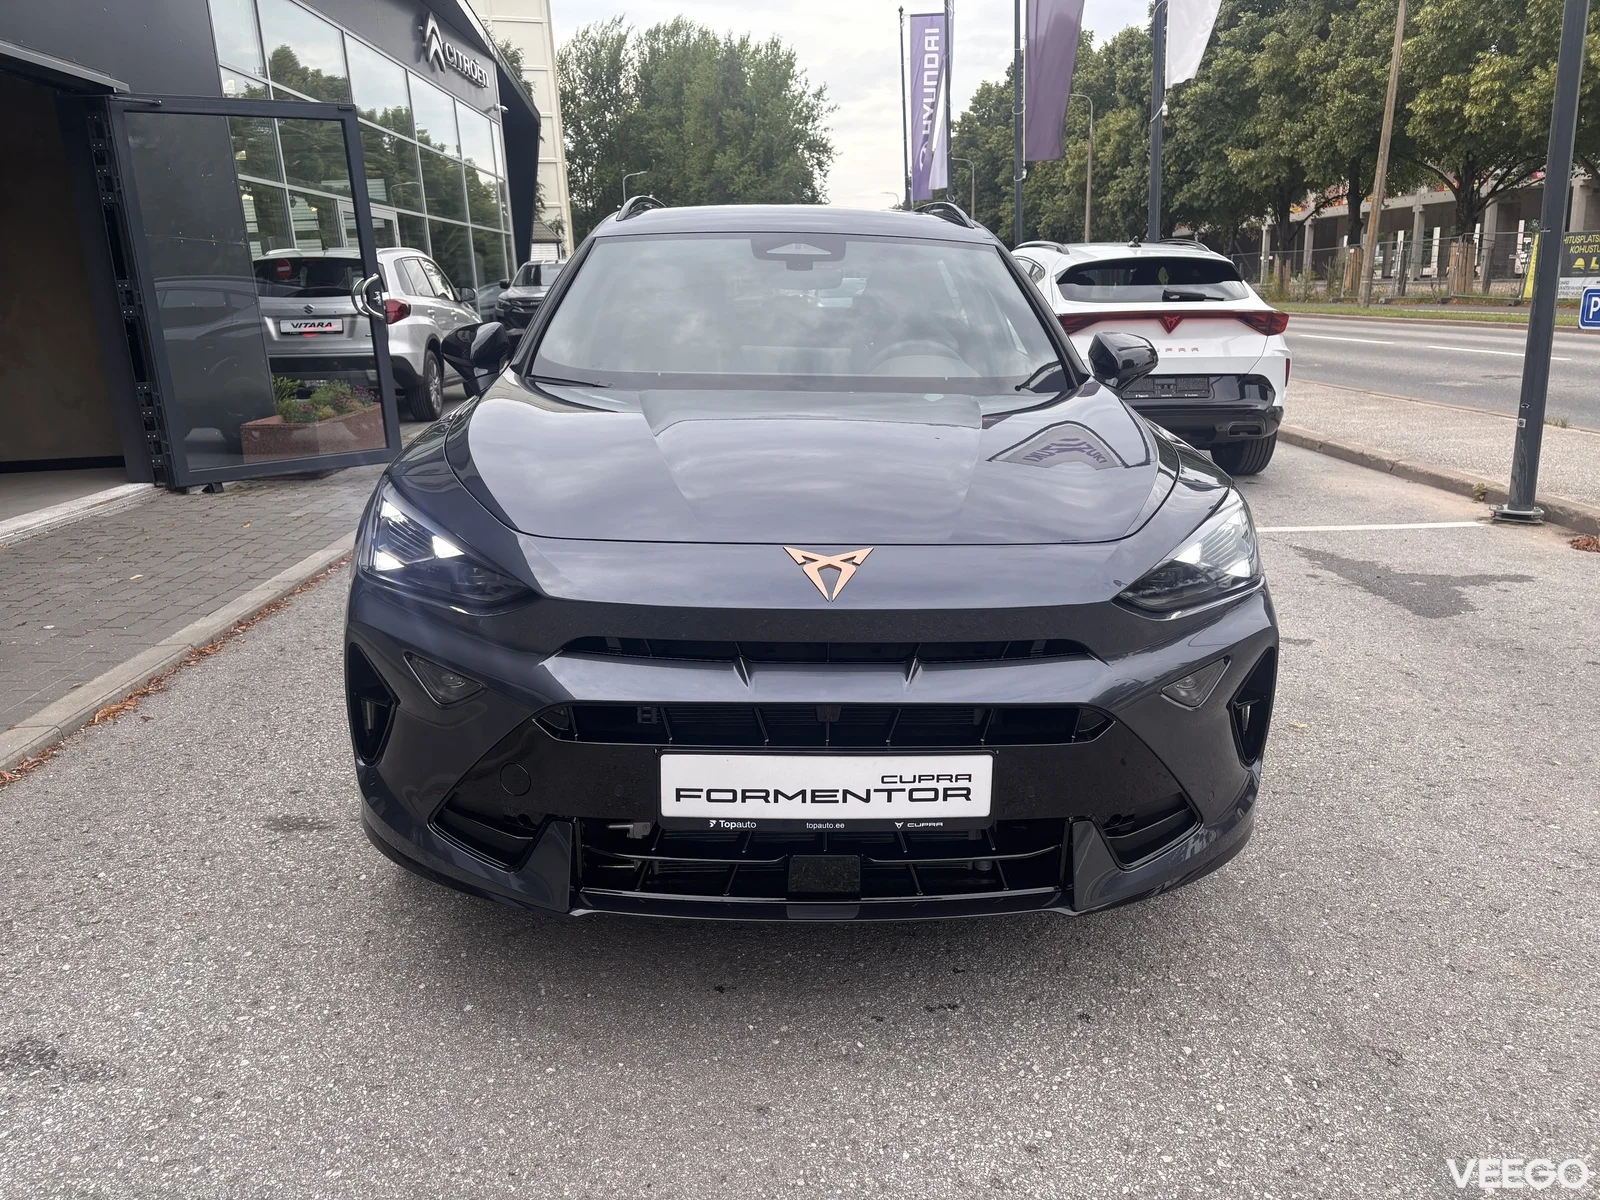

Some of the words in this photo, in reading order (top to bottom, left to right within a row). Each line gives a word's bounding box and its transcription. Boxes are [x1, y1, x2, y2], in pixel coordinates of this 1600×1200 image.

[922, 28, 940, 135] HYUNDAI
[1589, 296, 1600, 319] P
[291, 321, 333, 329] VITARA
[881, 773, 972, 784] CUPRA
[675, 786, 972, 804] FORMENTOR
[718, 820, 757, 830] Topauto
[806, 822, 845, 830] topauto.ee
